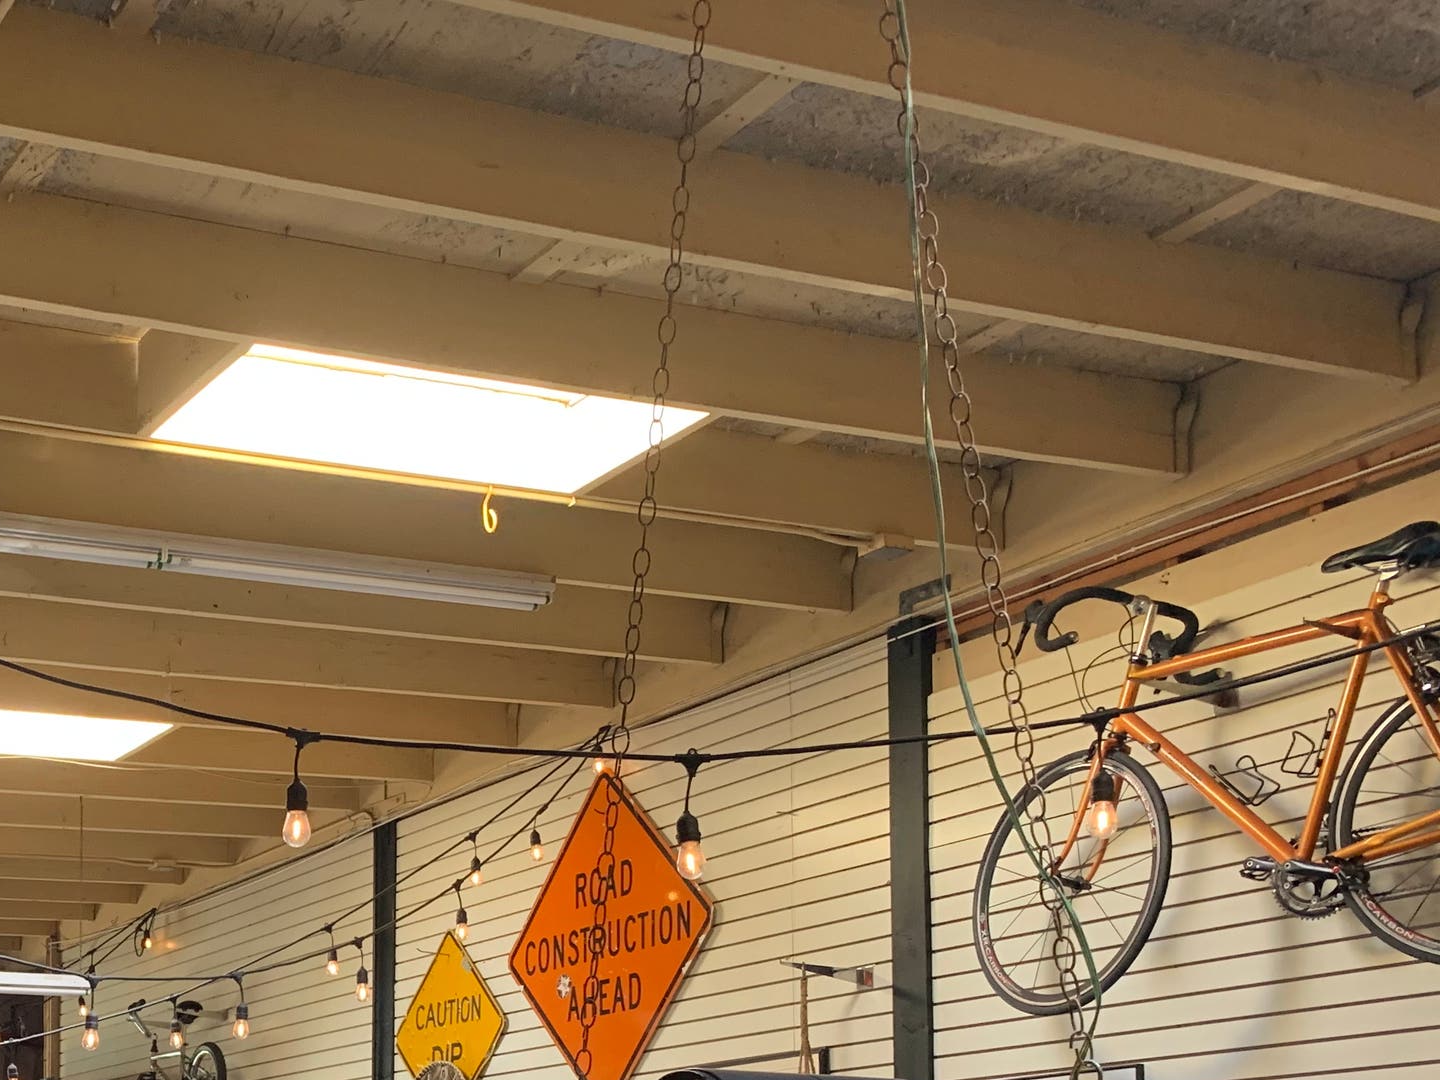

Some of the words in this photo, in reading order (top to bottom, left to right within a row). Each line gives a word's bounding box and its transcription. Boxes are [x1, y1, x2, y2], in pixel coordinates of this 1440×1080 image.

[575, 859, 633, 909] ROAD
[525, 901, 692, 976] CONSTRUCTION
[415, 994, 482, 1031] CAUTION
[567, 973, 642, 1022] AHEAD
